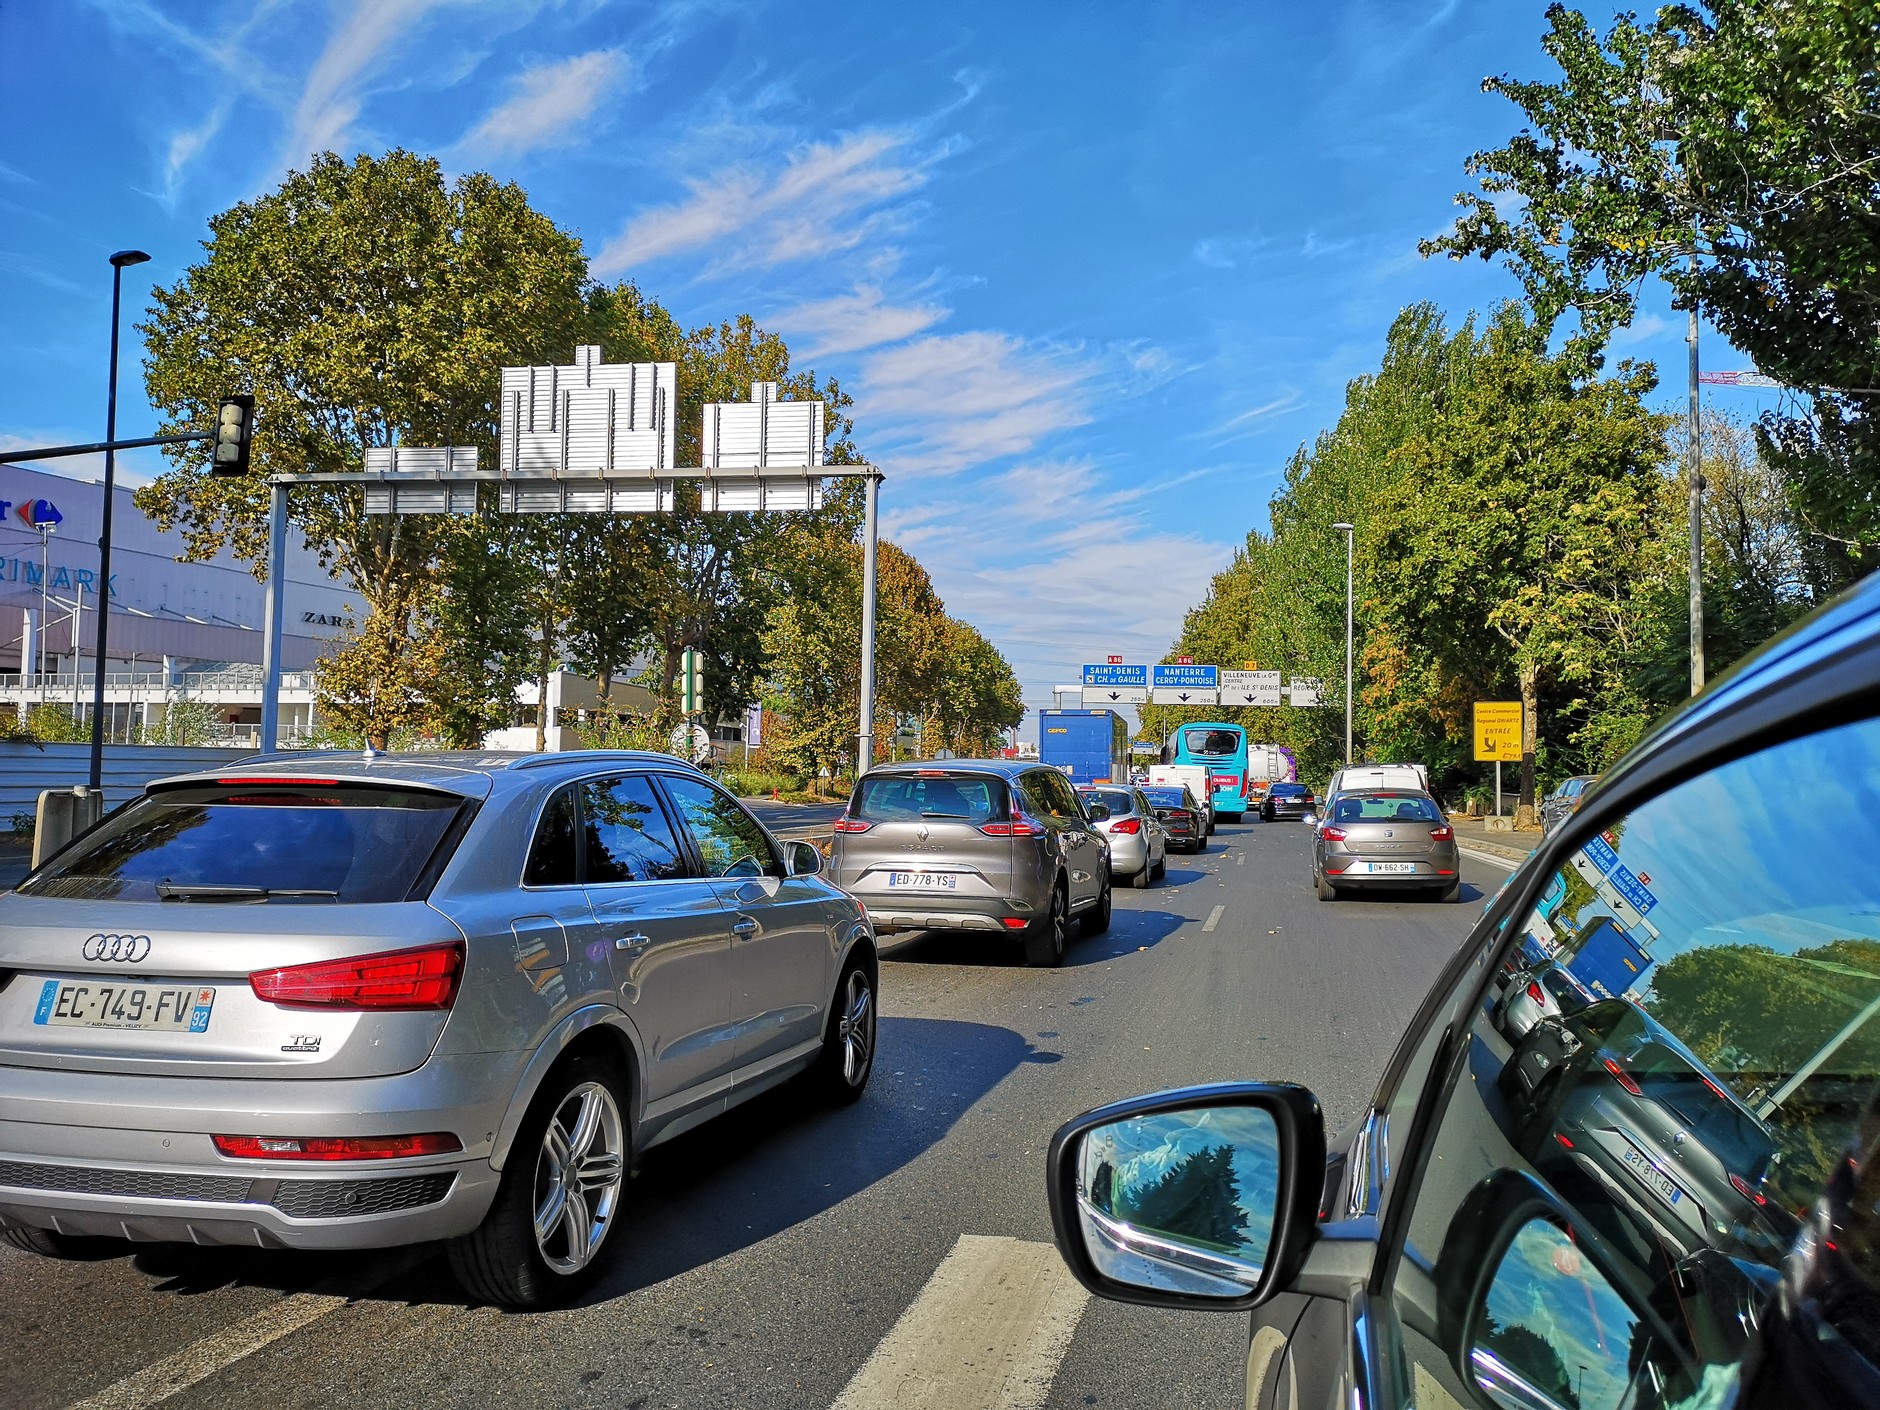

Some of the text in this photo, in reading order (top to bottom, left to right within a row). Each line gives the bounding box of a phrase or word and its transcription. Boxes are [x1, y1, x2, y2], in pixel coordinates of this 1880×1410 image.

[1156, 676, 1214, 684] CERGY-PONTOISE
[897, 874, 948, 887] ED-778-YS
[54, 987, 192, 1022] EC-749-FV
[39, 1007, 47, 1015] F
[191, 1011, 208, 1027] 92
[290, 1034, 321, 1045] TDI
